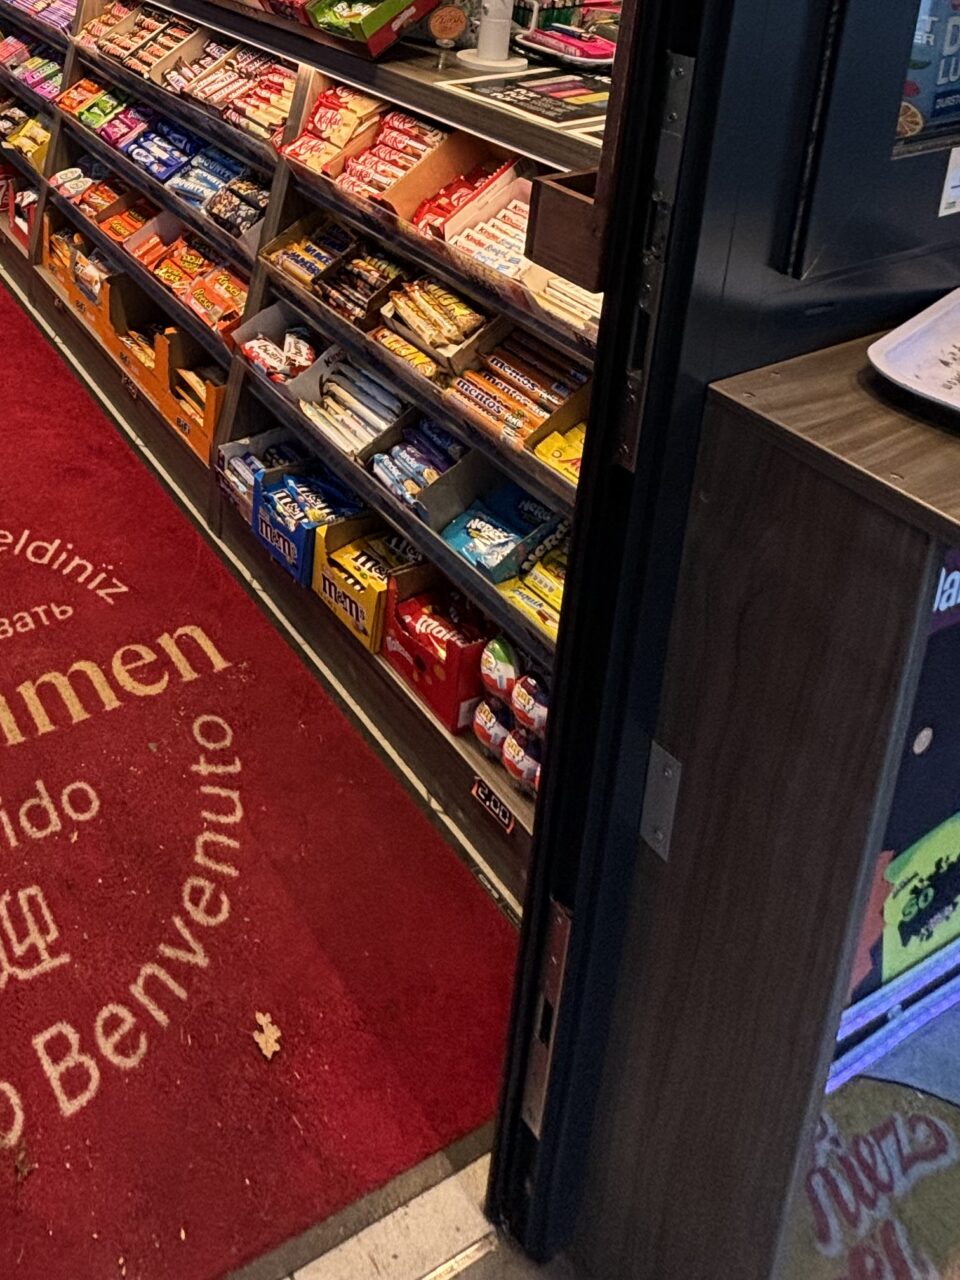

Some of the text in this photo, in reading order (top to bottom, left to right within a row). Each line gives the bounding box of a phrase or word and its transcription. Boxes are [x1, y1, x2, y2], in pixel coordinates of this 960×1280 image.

[317, 110, 343, 129] KitKat
[192, 288, 214, 310] Reese's
[490, 356, 538, 391] mentos
[457, 379, 503, 415] mentos
[31, 713, 244, 1119] Benvenuto
